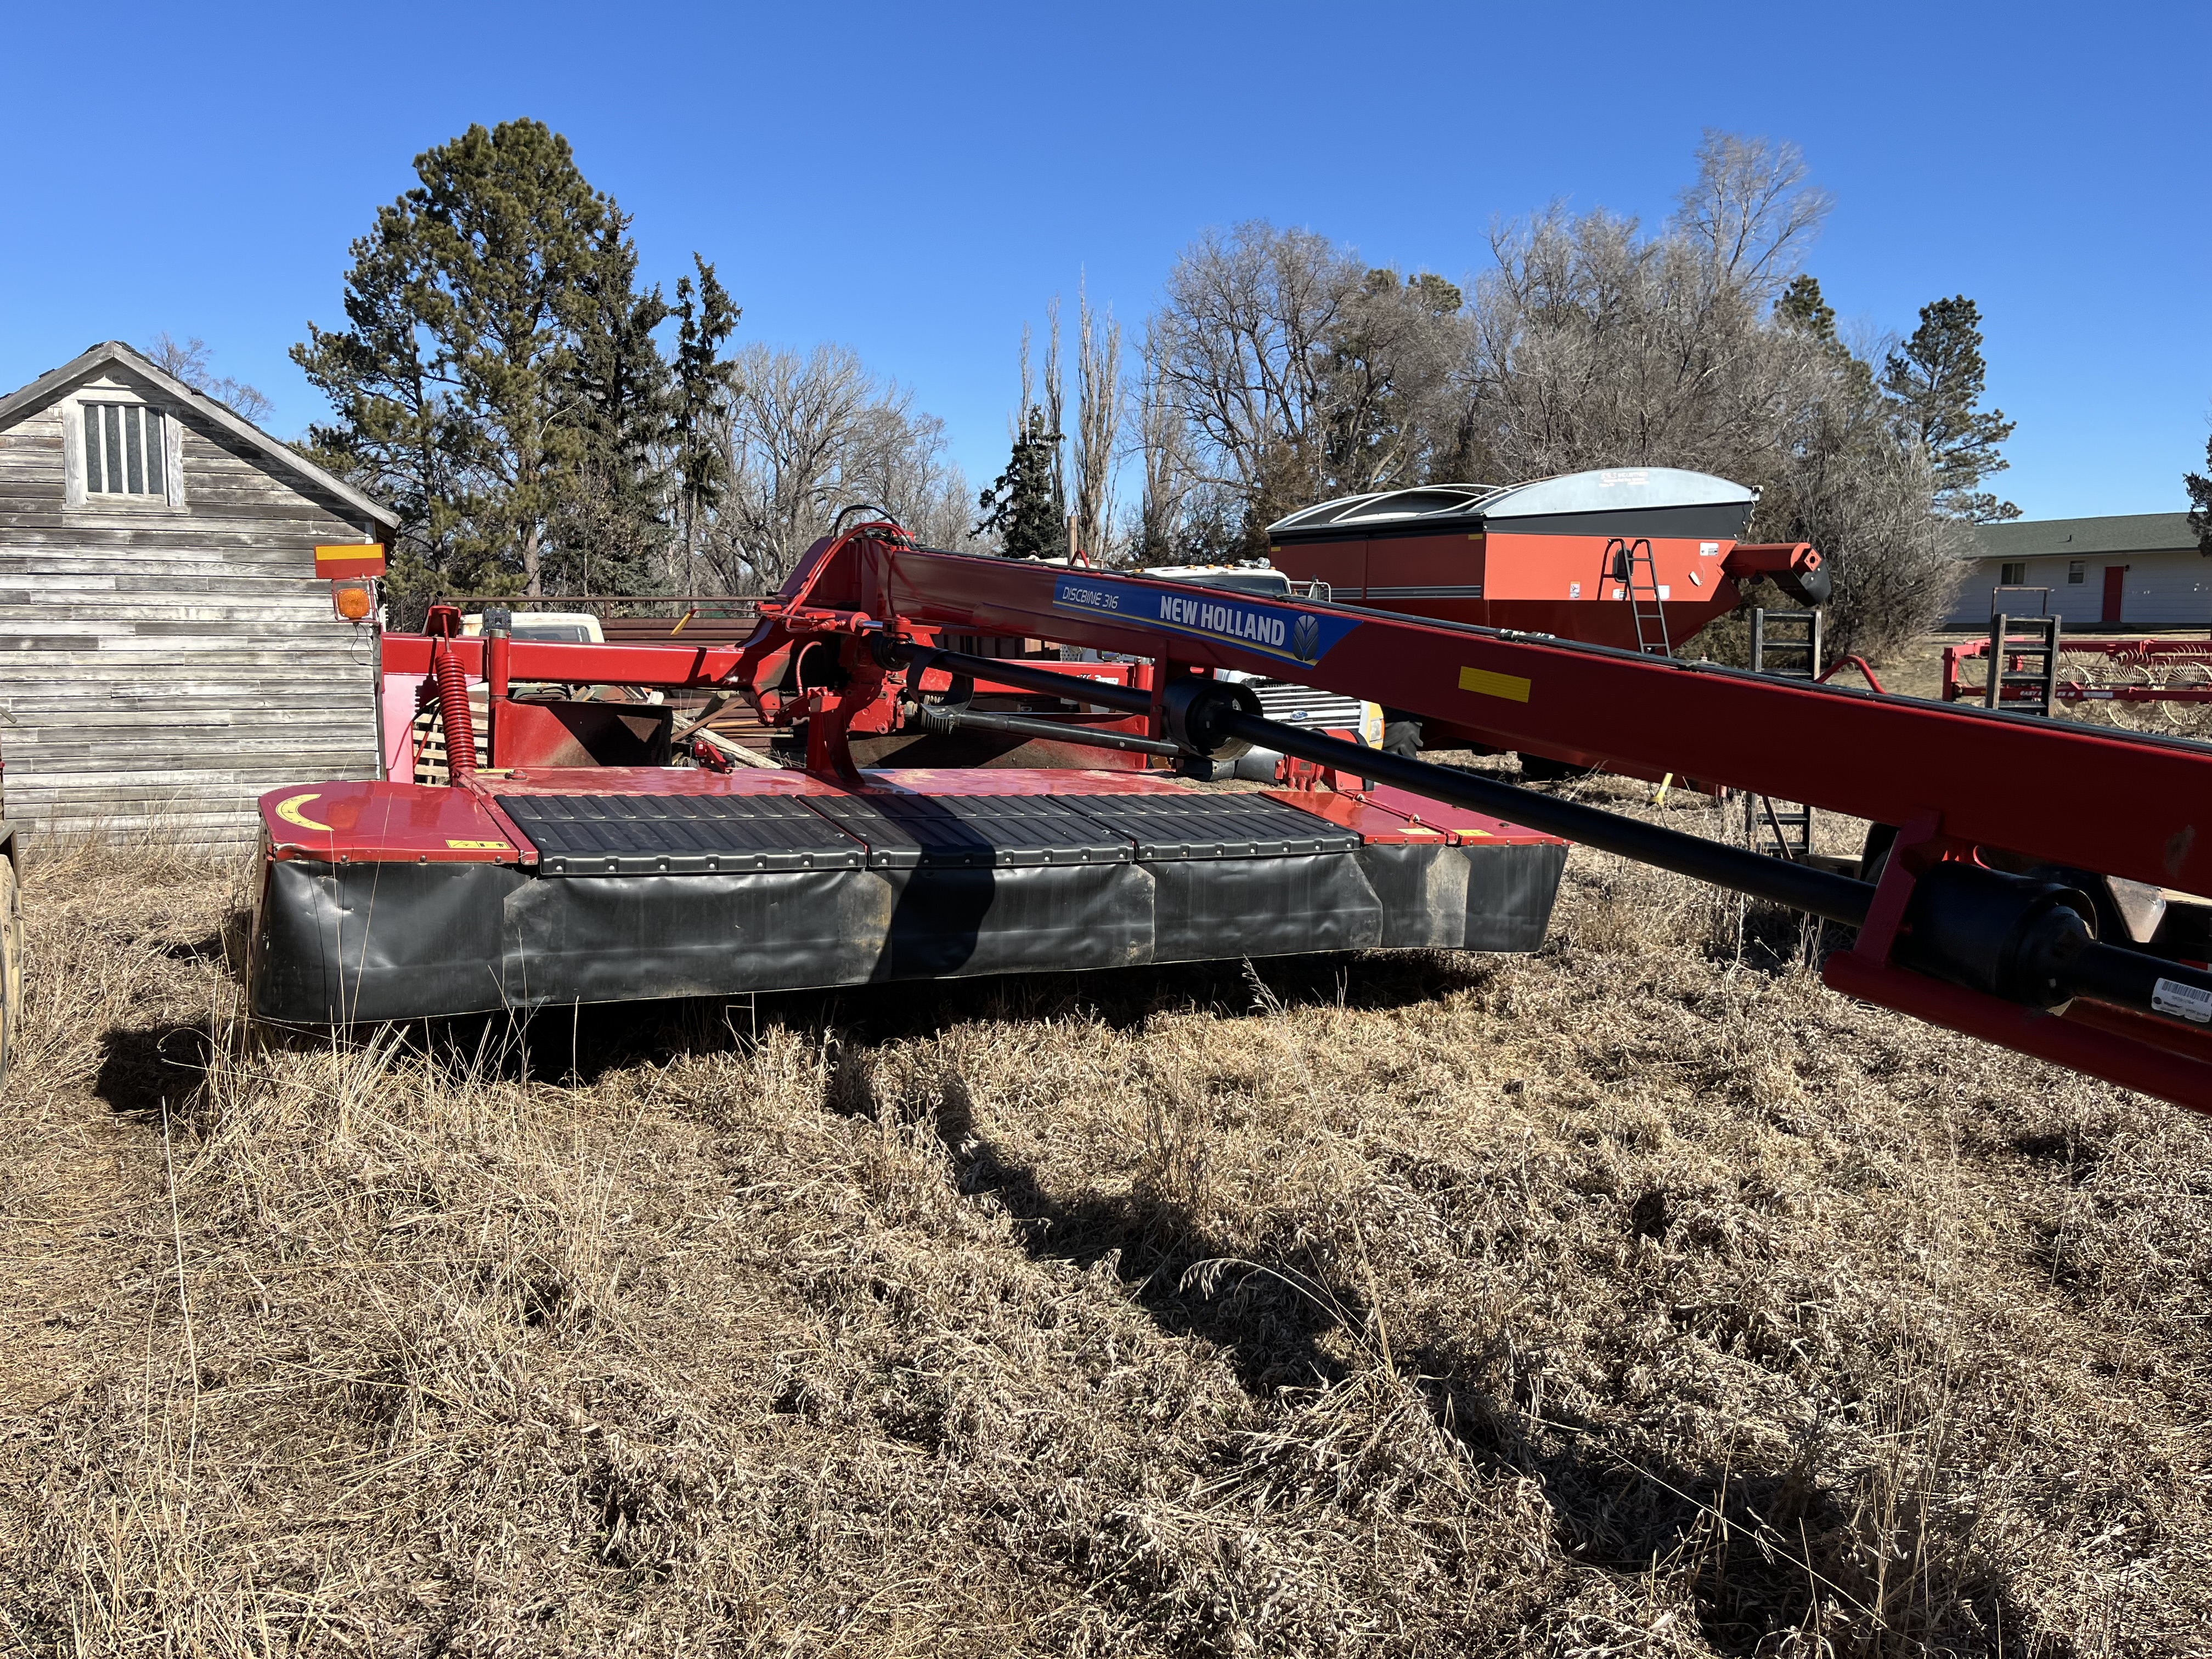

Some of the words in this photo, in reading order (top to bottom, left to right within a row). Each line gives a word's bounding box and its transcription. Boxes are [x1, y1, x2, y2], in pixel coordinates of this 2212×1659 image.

[1062, 586, 1102, 606] DISCBINE
[1102, 594, 1119, 609] 316
[1160, 595, 1198, 625] NEW
[1200, 603, 1285, 646] HOLLAND
